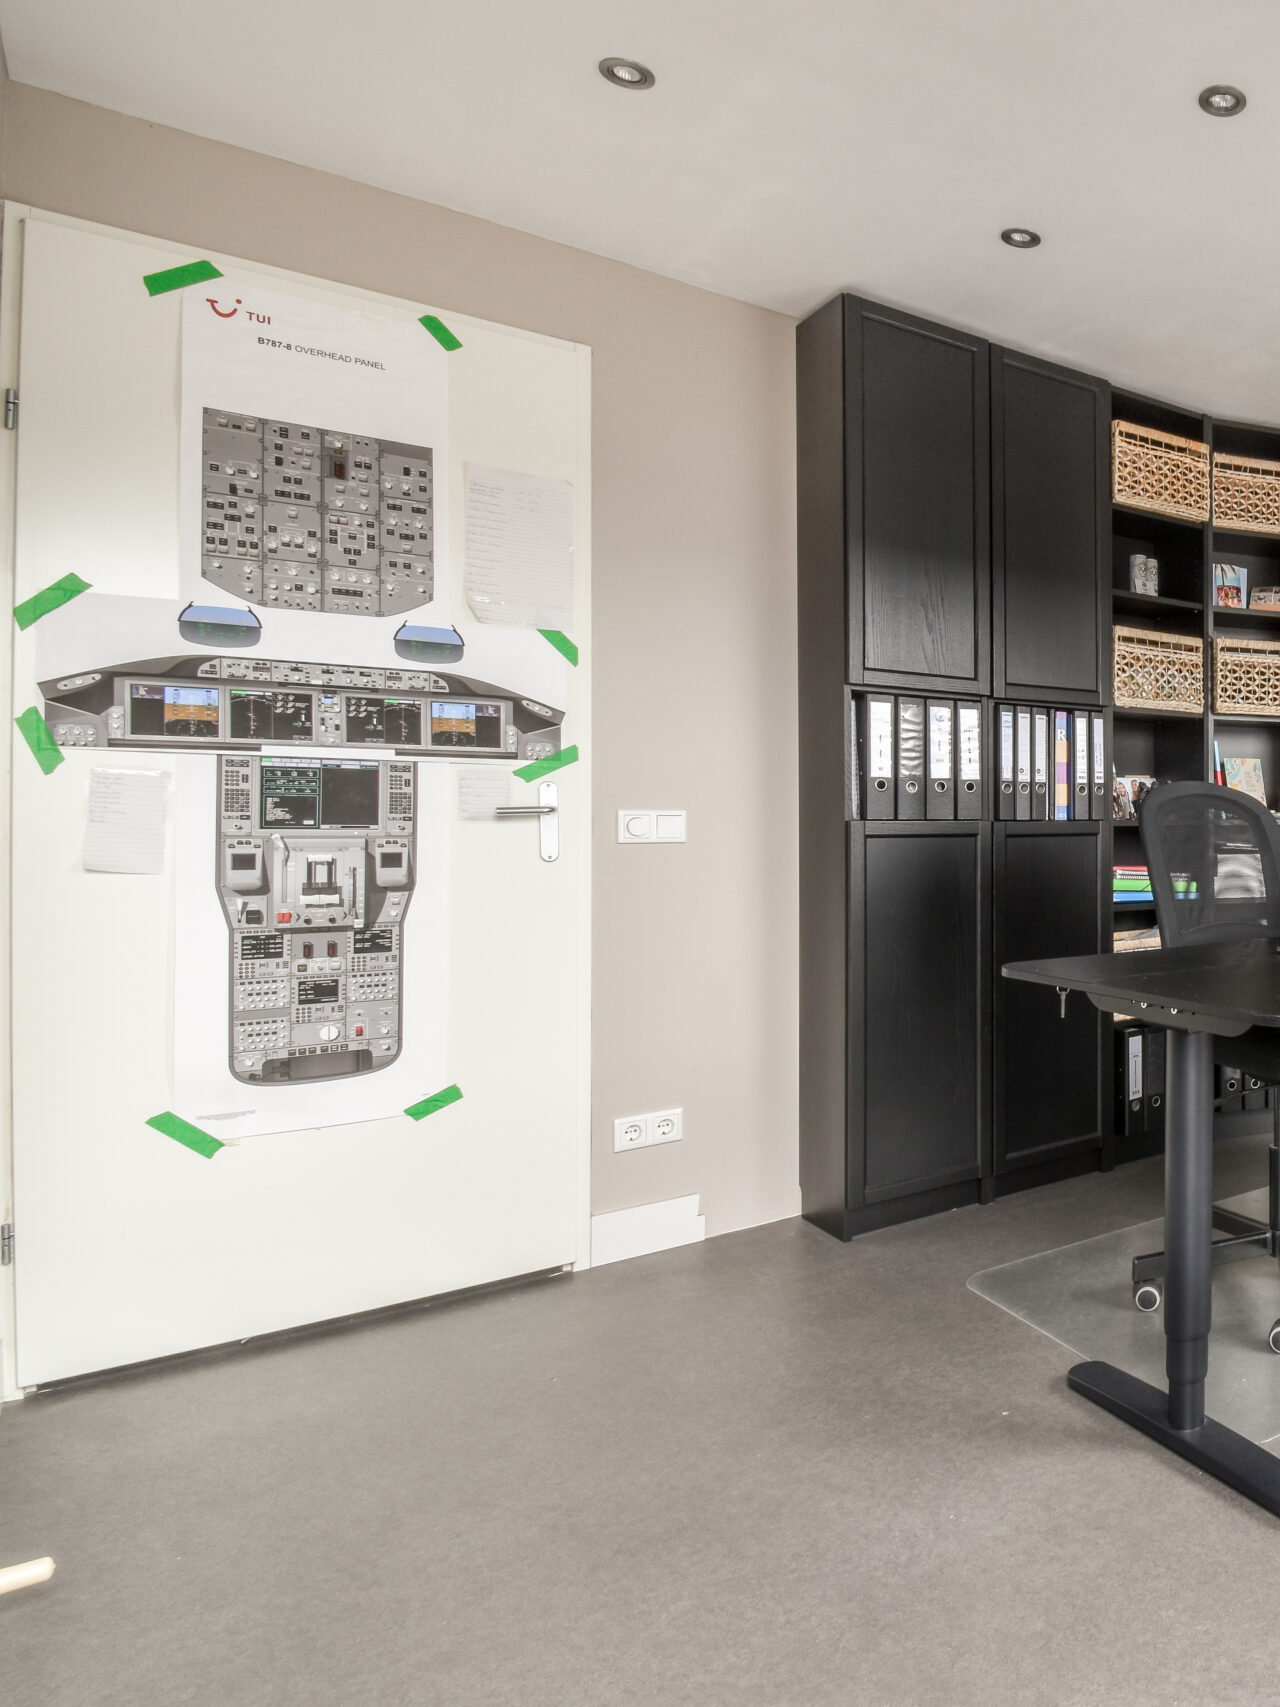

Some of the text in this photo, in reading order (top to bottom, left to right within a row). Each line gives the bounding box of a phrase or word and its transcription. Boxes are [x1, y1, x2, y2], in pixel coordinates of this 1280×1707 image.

[246, 311, 271, 325] TUI
[257, 336, 387, 371] B787-8 OVERHEAD PANEL
